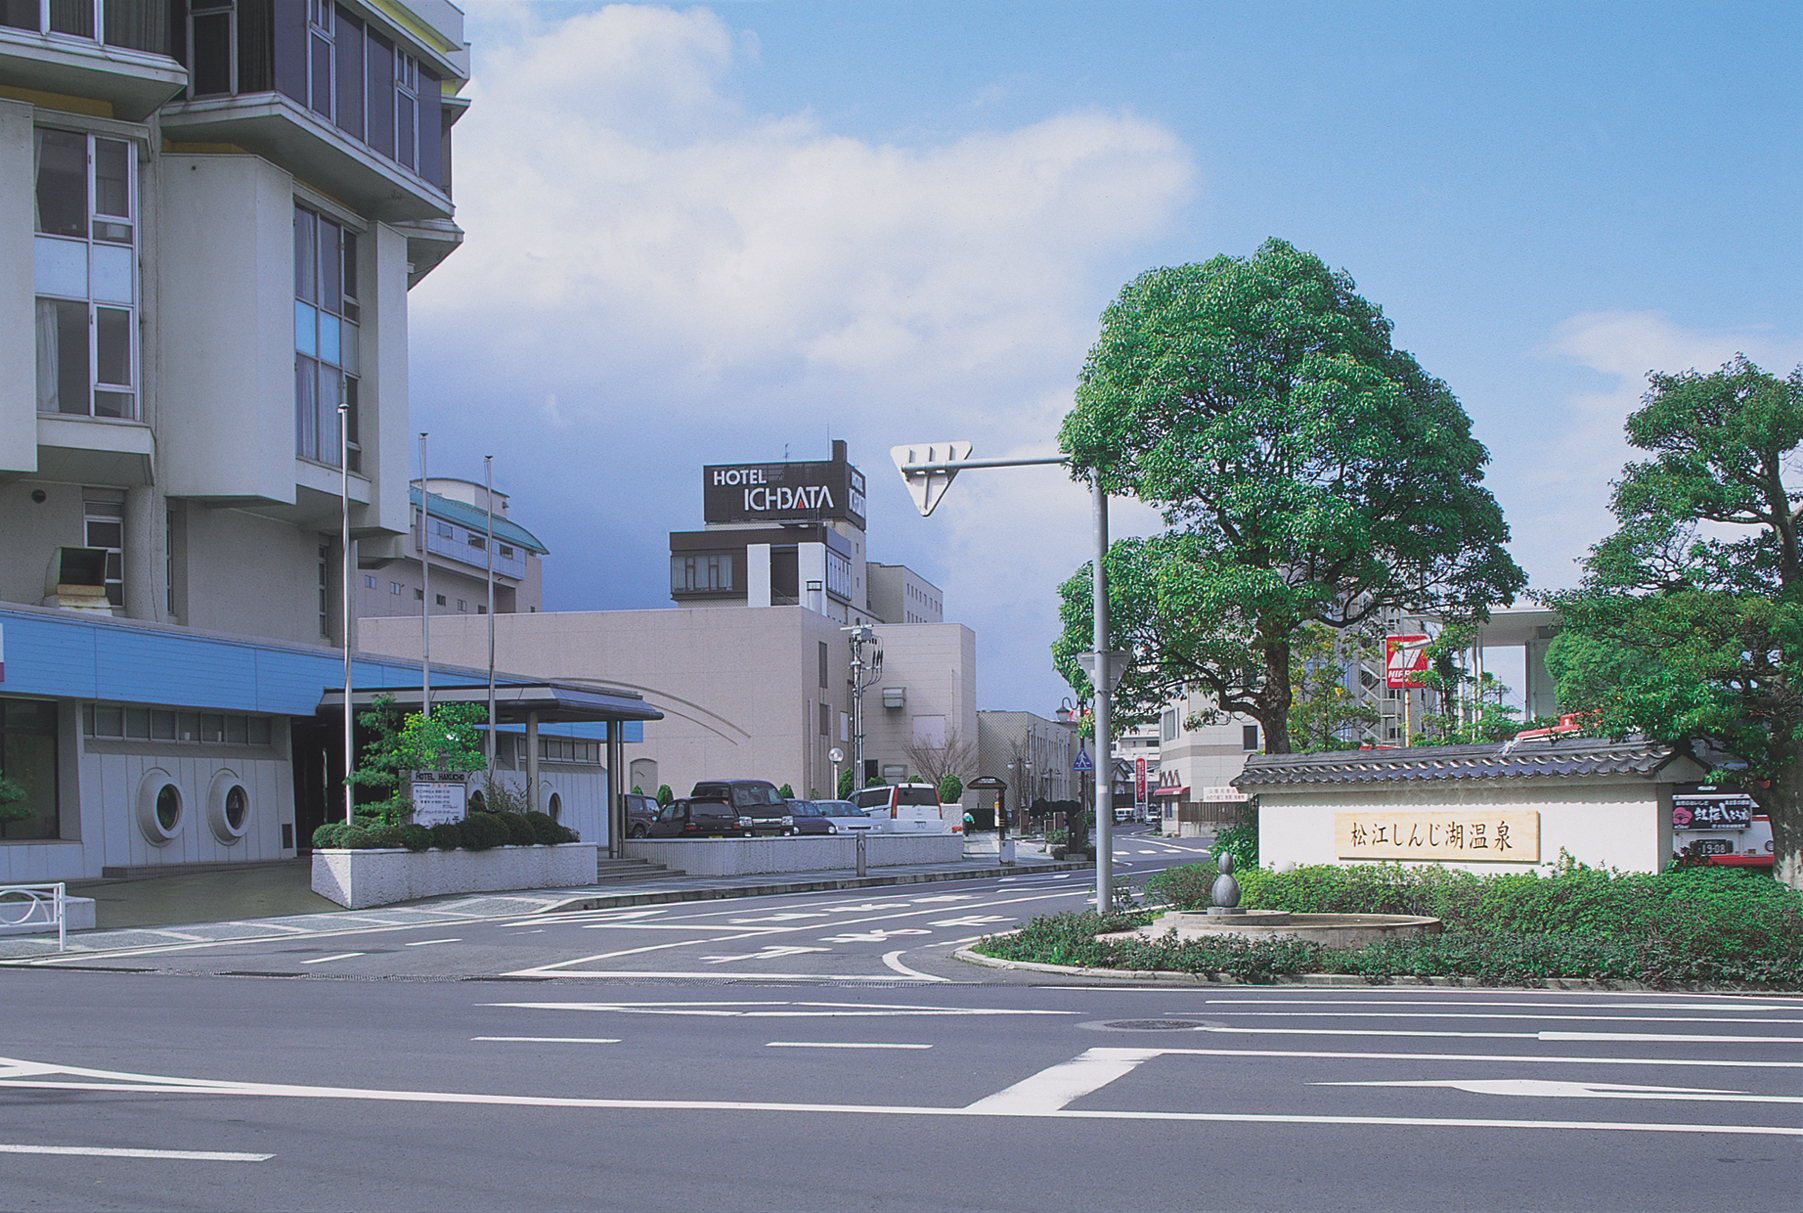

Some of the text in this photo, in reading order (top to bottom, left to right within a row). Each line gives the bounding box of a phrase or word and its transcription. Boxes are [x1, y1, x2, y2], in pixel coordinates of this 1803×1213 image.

[713, 469, 767, 486] HOTEL
[1388, 669, 1425, 678] NIPP
[1350, 820, 1513, 852] 松江しんじ湖温泉
